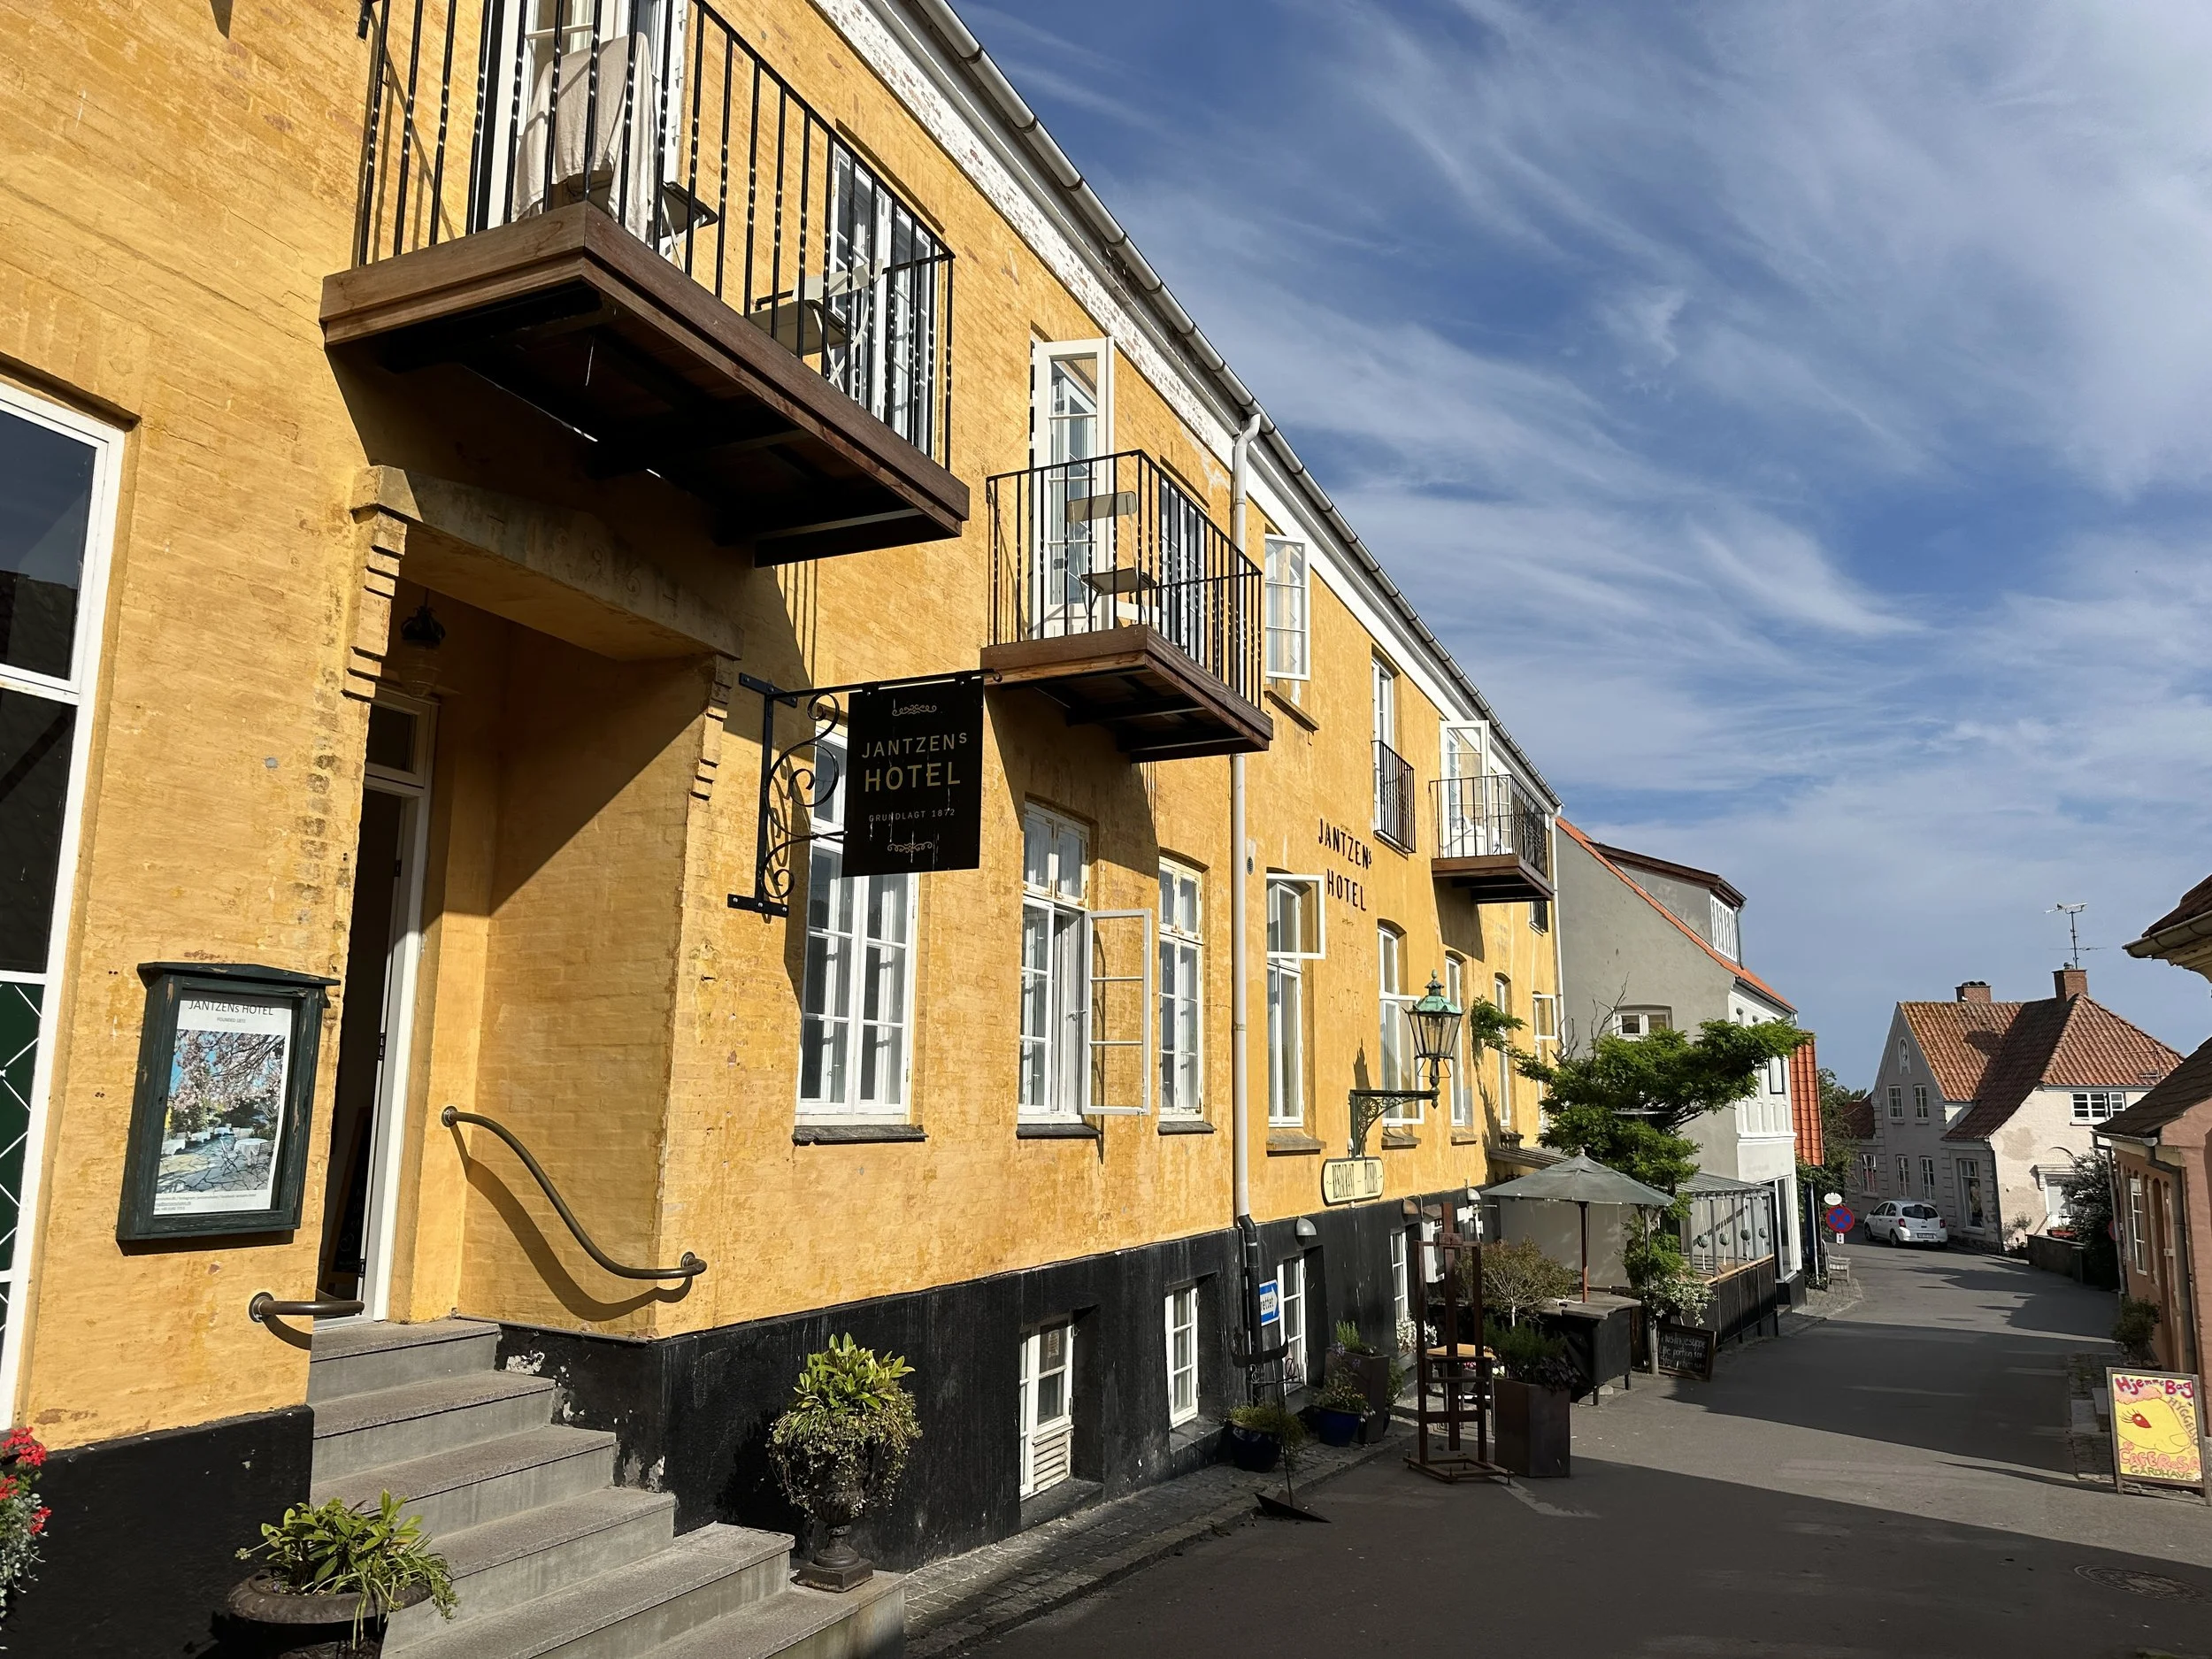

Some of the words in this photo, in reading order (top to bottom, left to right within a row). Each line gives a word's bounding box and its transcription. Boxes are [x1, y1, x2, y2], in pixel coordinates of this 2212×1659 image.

[864, 761, 961, 793] HOTEL
[869, 810, 926, 822] GRUNDLAGT
[932, 808, 956, 818] 1872
[1327, 868, 1367, 911] HOTEL
[242, 1005, 274, 1016] HOTEL
